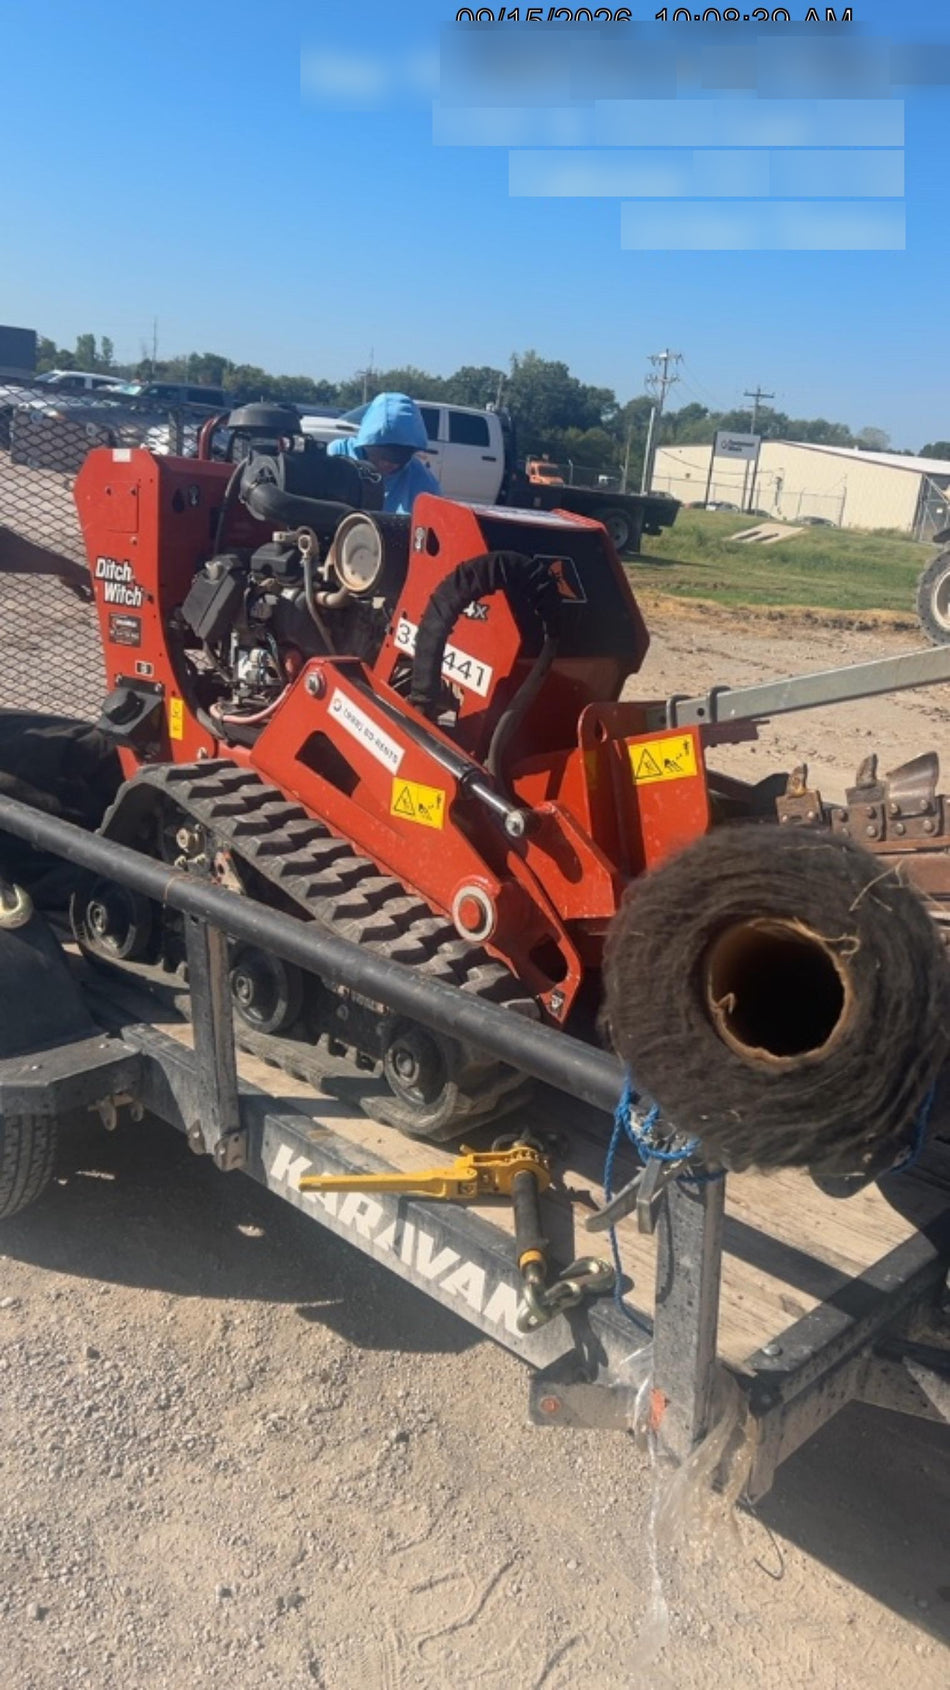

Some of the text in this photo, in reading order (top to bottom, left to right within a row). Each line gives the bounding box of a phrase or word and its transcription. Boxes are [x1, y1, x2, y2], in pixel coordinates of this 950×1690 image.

[94, 556, 133, 582] Ditch
[104, 581, 142, 607] Witch
[397, 623, 485, 687] 3441
